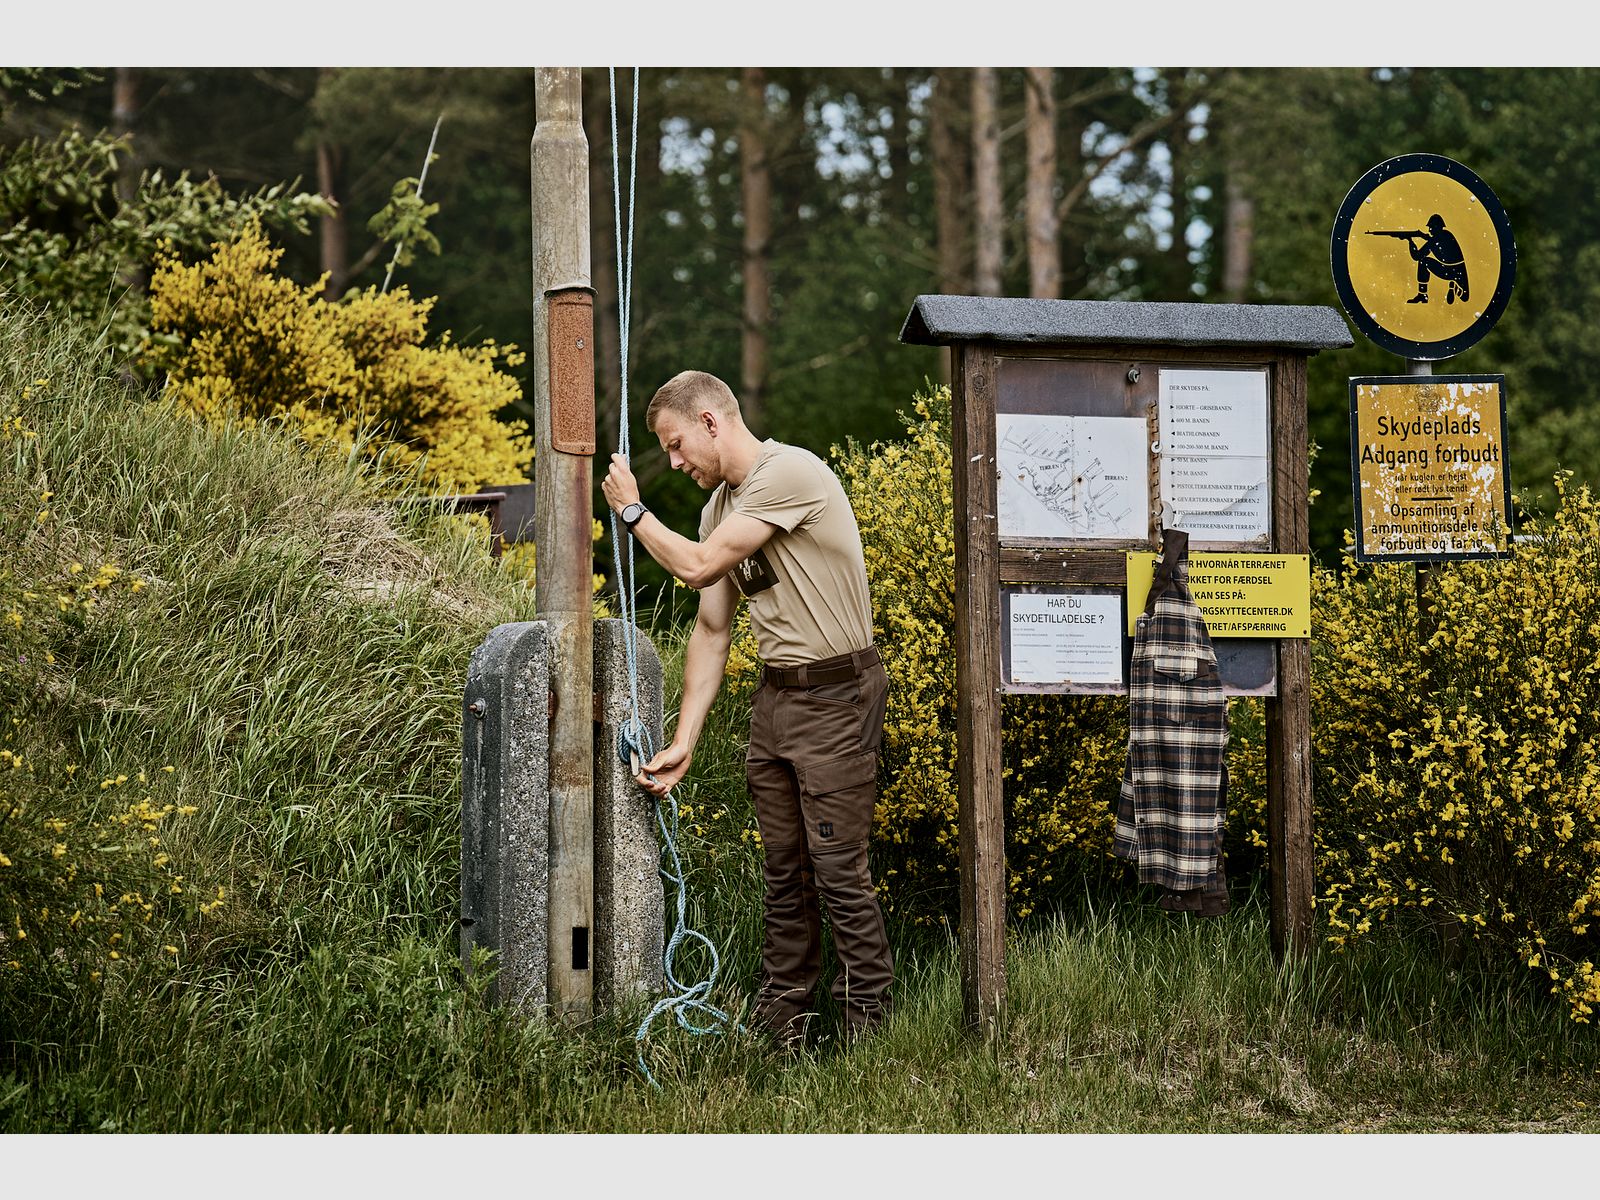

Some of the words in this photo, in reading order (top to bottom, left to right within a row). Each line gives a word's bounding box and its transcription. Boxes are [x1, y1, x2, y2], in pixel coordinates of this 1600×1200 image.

[1377, 415, 1481, 441] Skydeplads
[1361, 444, 1428, 470] Adgang
[1435, 443, 1499, 462] forbudt
[1410, 473, 1435, 483] kuglen
[1448, 472, 1467, 482] hejst
[1395, 485, 1412, 493] eller
[1414, 485, 1430, 493] rødt
[1432, 485, 1444, 495] lys
[1446, 485, 1468, 493] tændt
[1390, 503, 1457, 520] Opsamling
[1463, 503, 1475, 515] af
[1371, 519, 1478, 534] ammunitionsdele
[1381, 537, 1427, 550] forbudt
[1432, 540, 1446, 552] og
[1451, 536, 1483, 552] farig
[1196, 558, 1239, 569] HVORNÅR
[1240, 560, 1287, 569] TERRÆNET
[1186, 575, 1212, 584] KKET
[1214, 576, 1231, 584] FOR
[1233, 576, 1272, 585] FÆRDSEL
[1194, 591, 1213, 600] KAN
[1215, 591, 1230, 600] SES
[1232, 589, 1246, 600] PÅ:
[1047, 599, 1065, 608] HAR
[1068, 599, 1081, 608] DU
[1198, 606, 1294, 616] RGSKYTTECENTER.DK
[1012, 613, 1096, 624] SKYDETILLADELSE
[1098, 615, 1104, 624] ?
[1207, 622, 1287, 632] TRET/AFSPÆRRING
